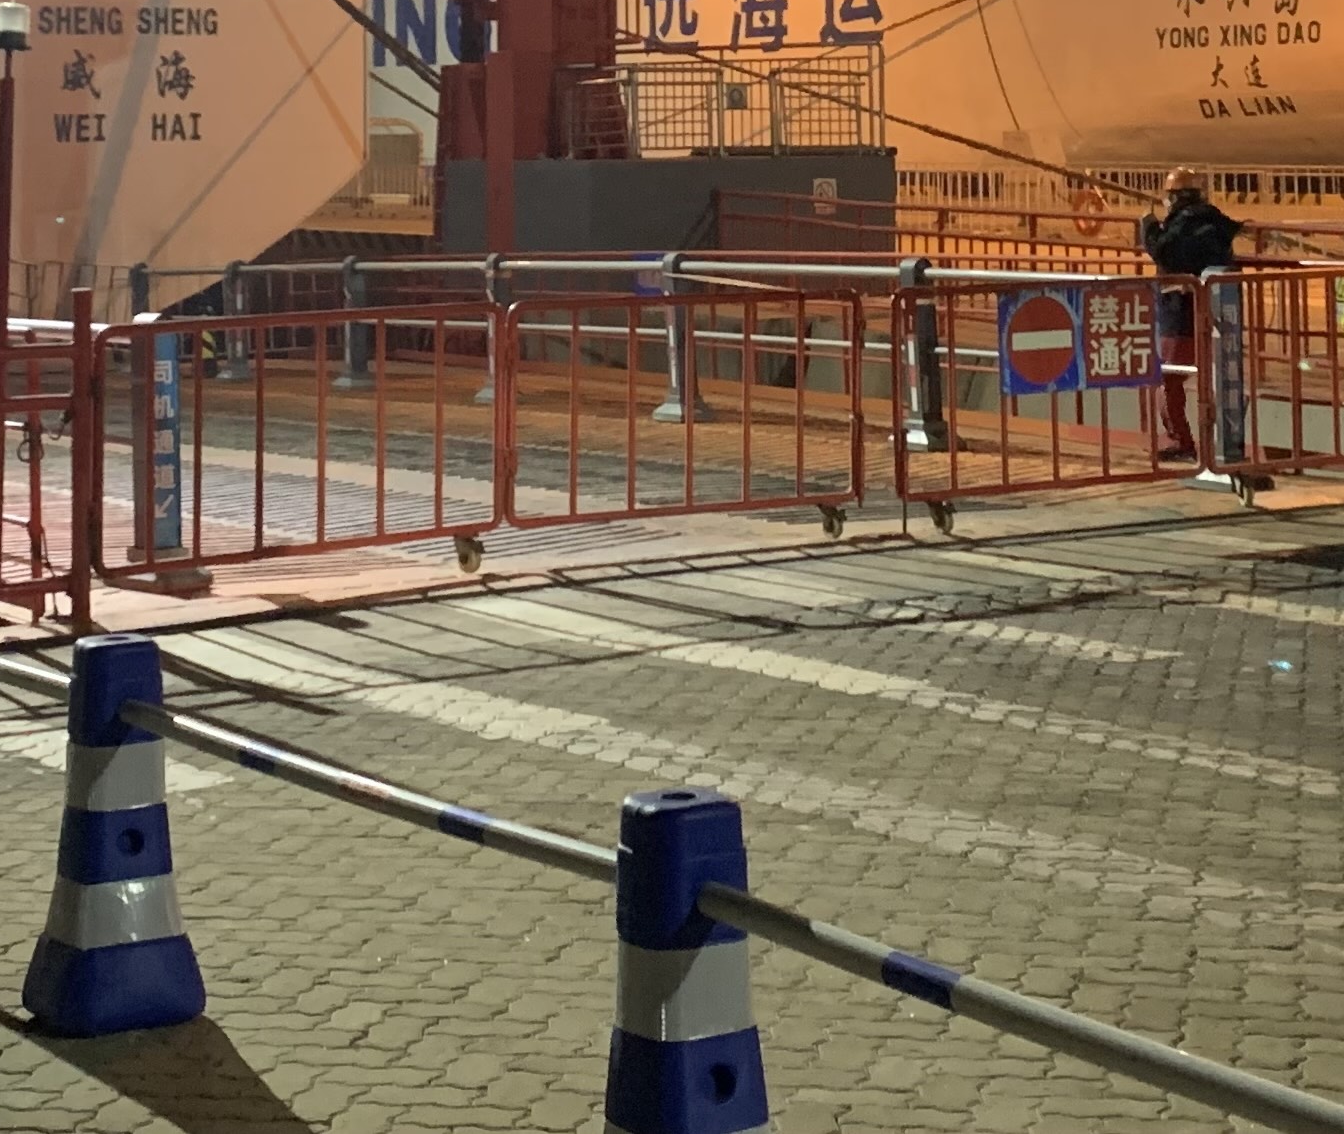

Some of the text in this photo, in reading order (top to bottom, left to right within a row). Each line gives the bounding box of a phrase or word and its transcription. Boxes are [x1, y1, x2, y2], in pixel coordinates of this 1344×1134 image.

[38, 6, 219, 36] SHENG SHENG
[1155, 20, 1321, 50] YONG XING DAO
[1198, 95, 1297, 119] DA LIAN
[55, 114, 202, 142] WEI HAI
[1089, 294, 1151, 335] 禁止
[1090, 335, 1152, 378] 通行
